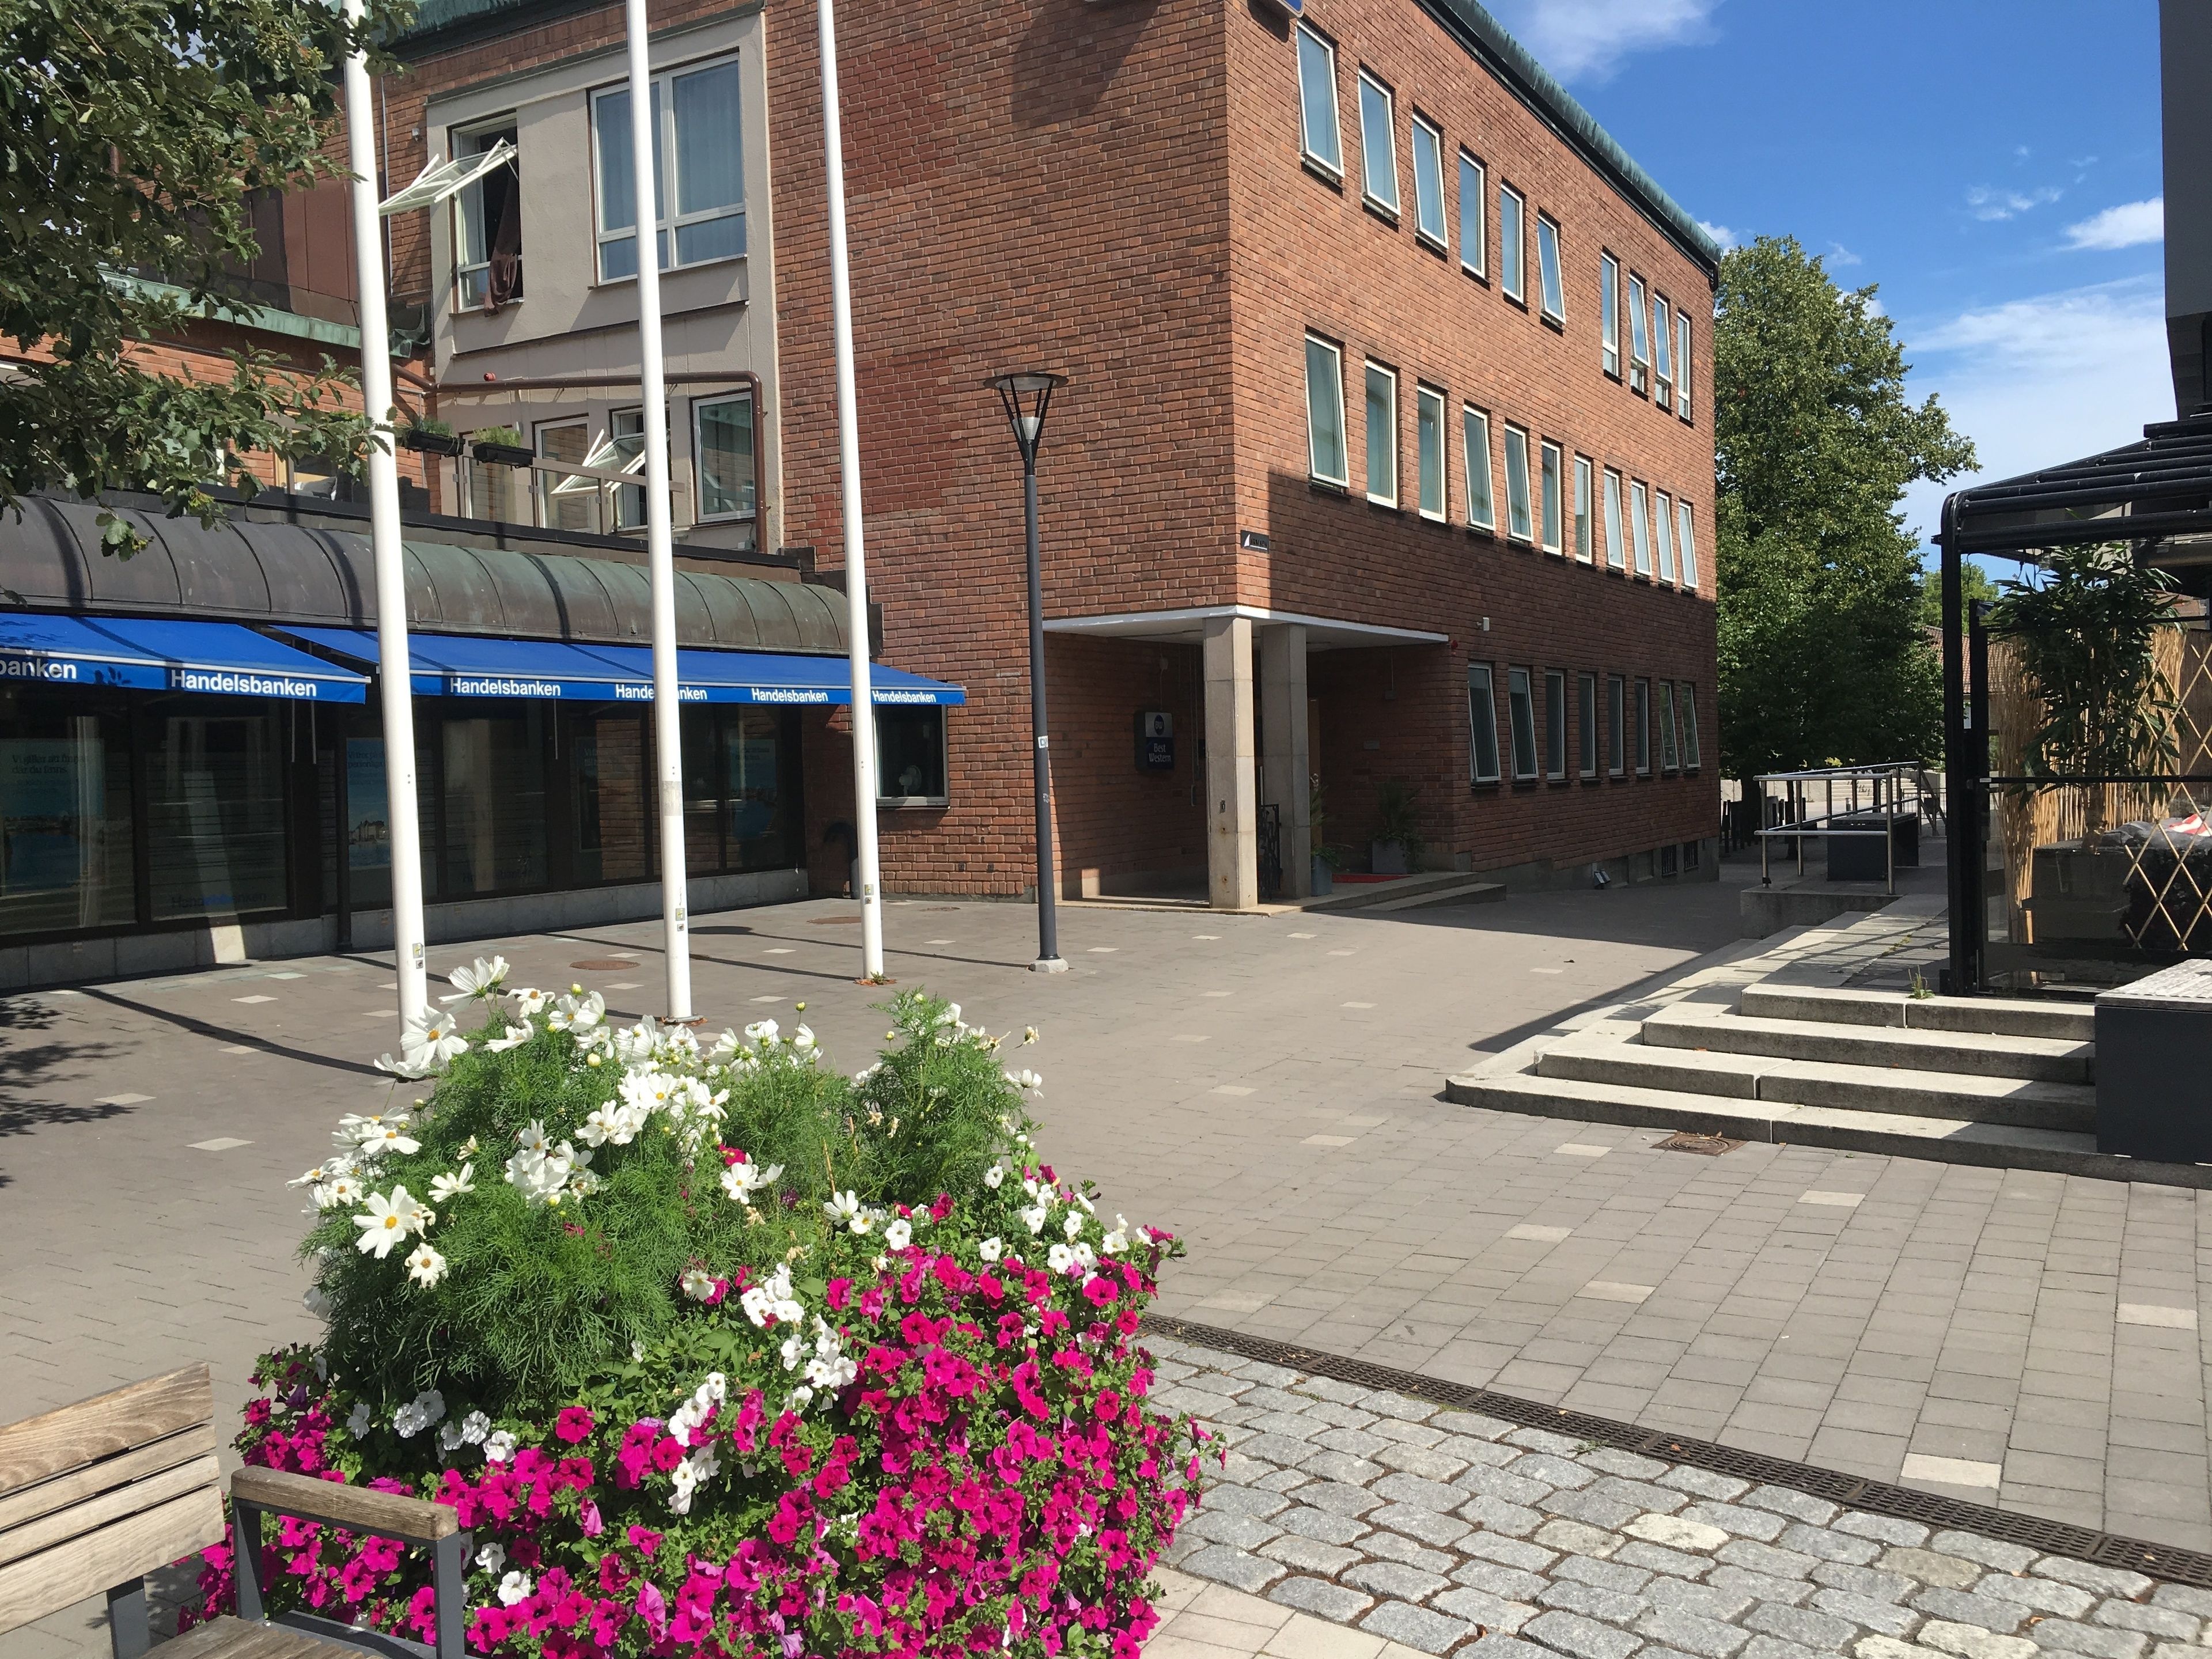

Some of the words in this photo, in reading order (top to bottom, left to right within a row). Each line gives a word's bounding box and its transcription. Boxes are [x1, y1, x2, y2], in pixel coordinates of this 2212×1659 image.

[171, 669, 317, 697] Handelsbanken
[450, 677, 561, 696] Handelsbanken
[615, 684, 707, 700] Handenken
[751, 687, 829, 702] Handelsbanken
[872, 690, 937, 703] Handelsbanken
[1155, 721, 1162, 729] BW
[1154, 743, 1166, 752] Best
[1149, 753, 1171, 763] Western
